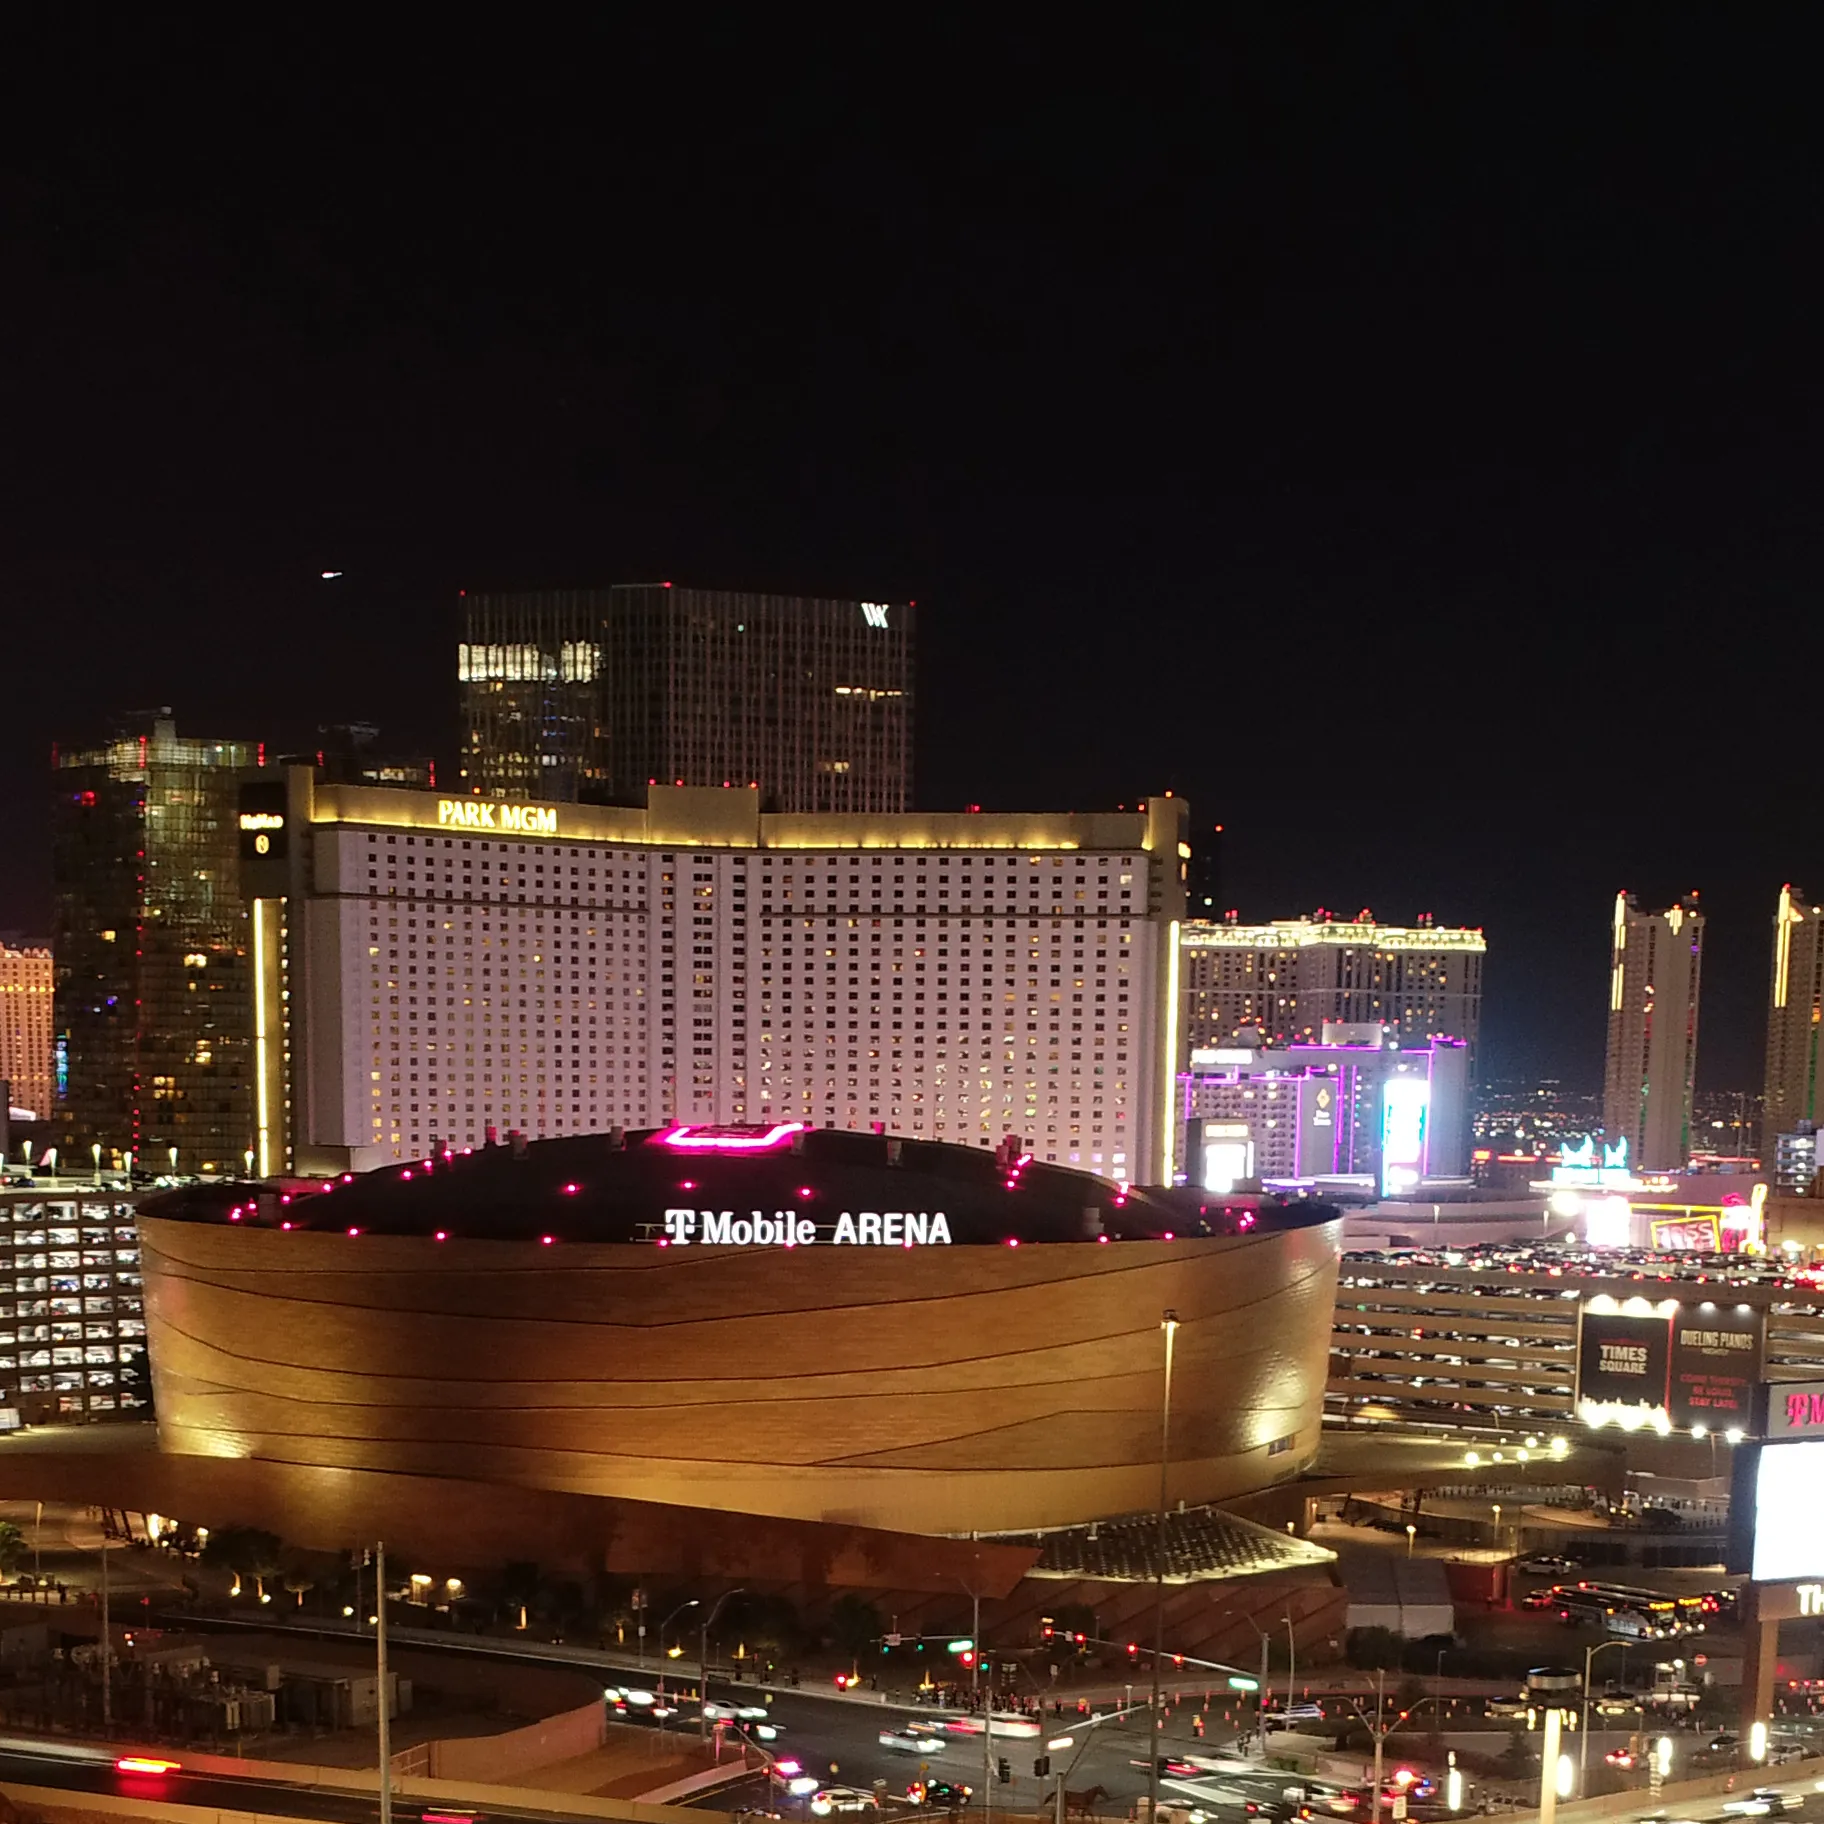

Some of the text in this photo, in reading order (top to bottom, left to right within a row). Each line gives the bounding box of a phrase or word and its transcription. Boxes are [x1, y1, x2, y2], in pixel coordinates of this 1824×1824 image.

[437, 799, 558, 833] PARK MGM
[832, 1211, 953, 1247] ARENA
[1680, 1329, 1754, 1351] DUELING PIANOS
[1599, 1344, 1648, 1363] TIMES
[1598, 1360, 1648, 1375] SQUARE
